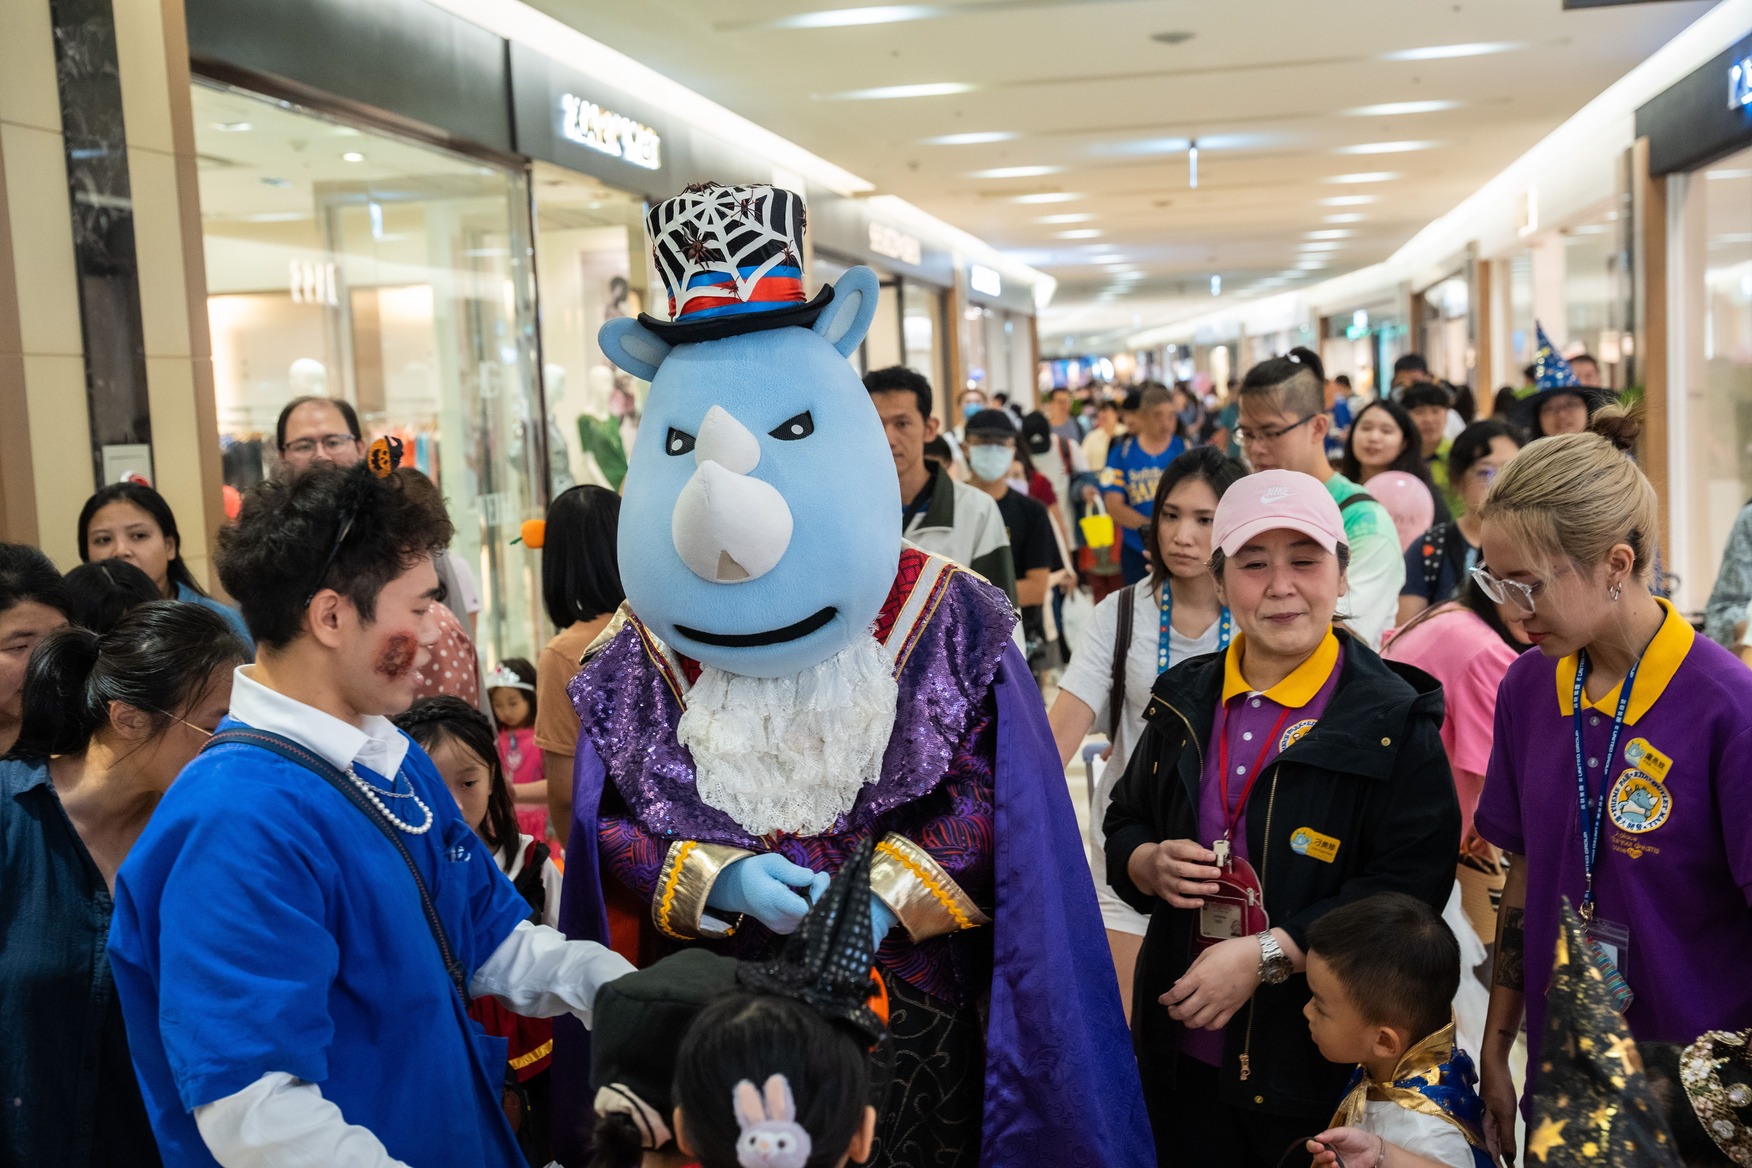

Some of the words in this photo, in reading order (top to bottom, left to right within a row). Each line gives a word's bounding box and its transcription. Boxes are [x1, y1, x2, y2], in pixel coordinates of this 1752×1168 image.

[1265, 486, 1289, 496] NIKE
[1609, 730, 1618, 752] UNITED
[1611, 788, 1620, 813] THEME
[1652, 781, 1668, 810] OUTLET
[1649, 811, 1666, 827] MALL
